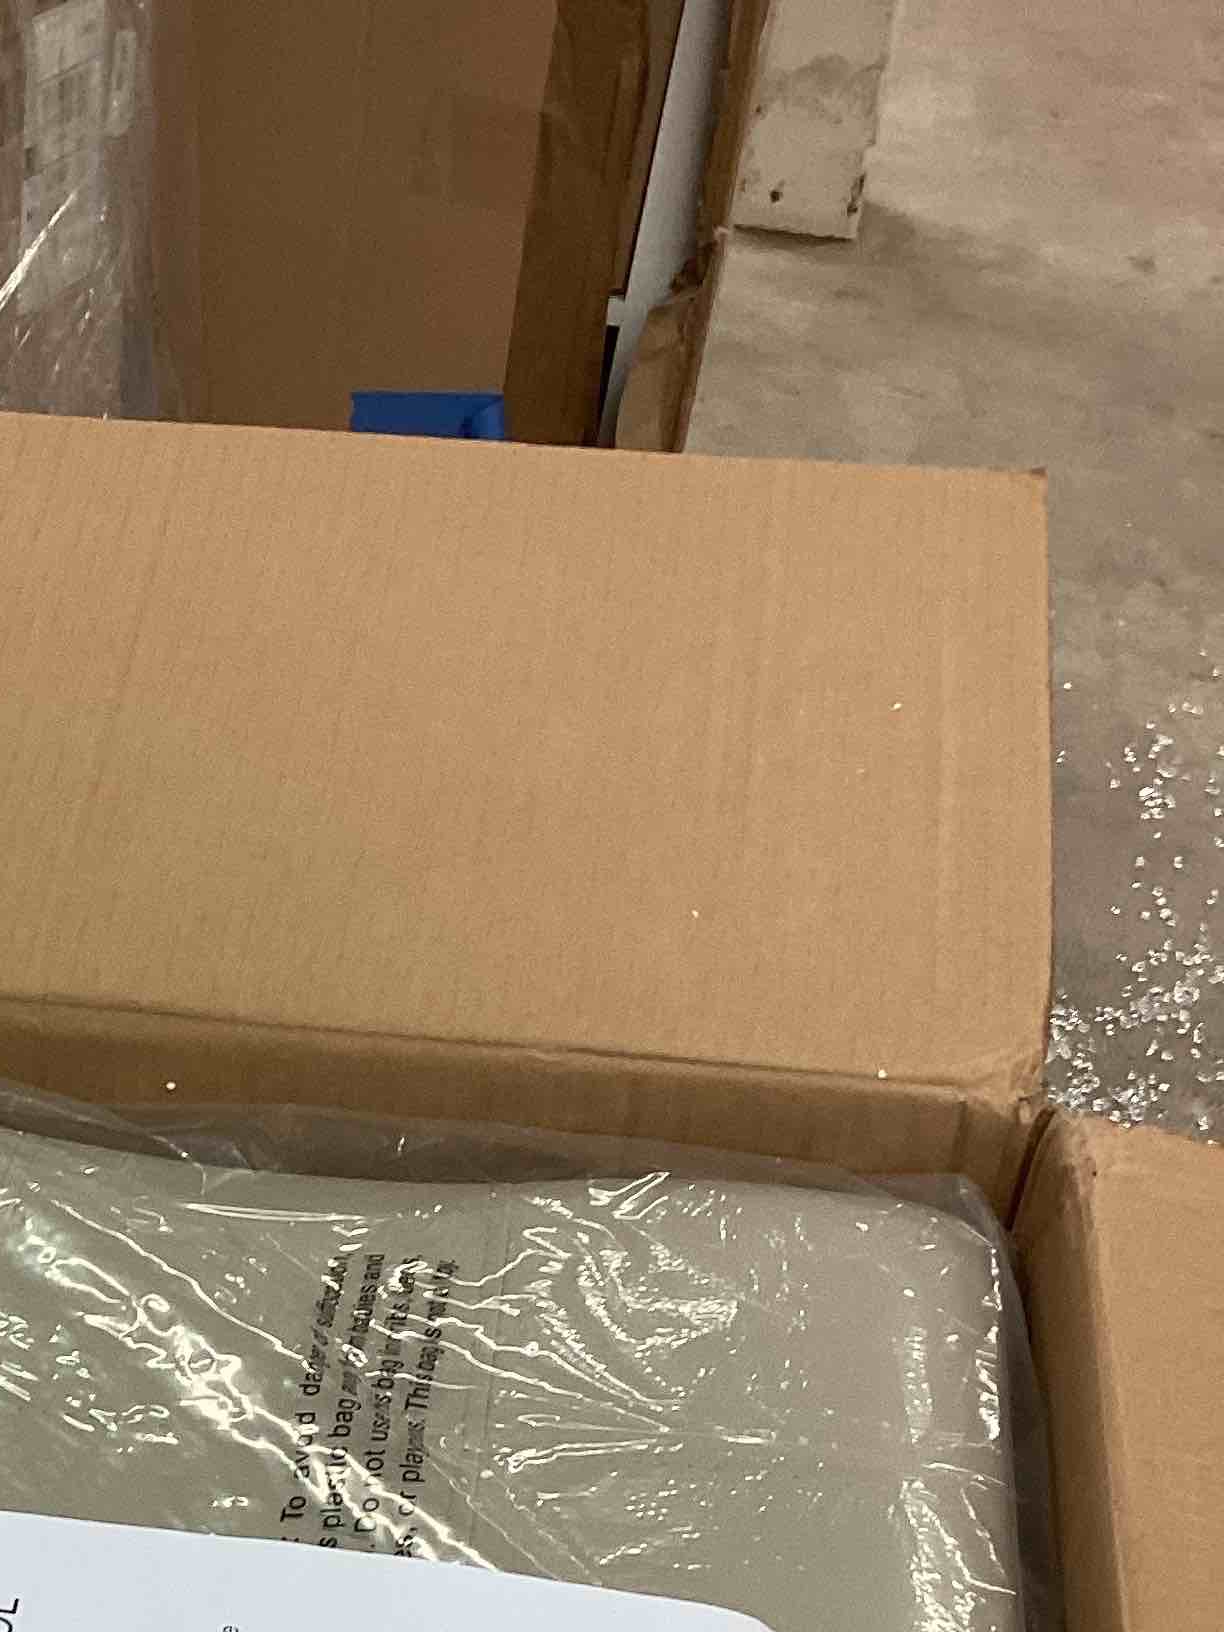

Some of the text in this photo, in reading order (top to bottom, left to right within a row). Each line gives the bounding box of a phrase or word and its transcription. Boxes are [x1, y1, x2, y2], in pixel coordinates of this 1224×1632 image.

[327, 1396, 362, 1437] bag
[362, 1253, 385, 1280] and
[292, 1410, 317, 1479] avod
[279, 1494, 307, 1521] To
